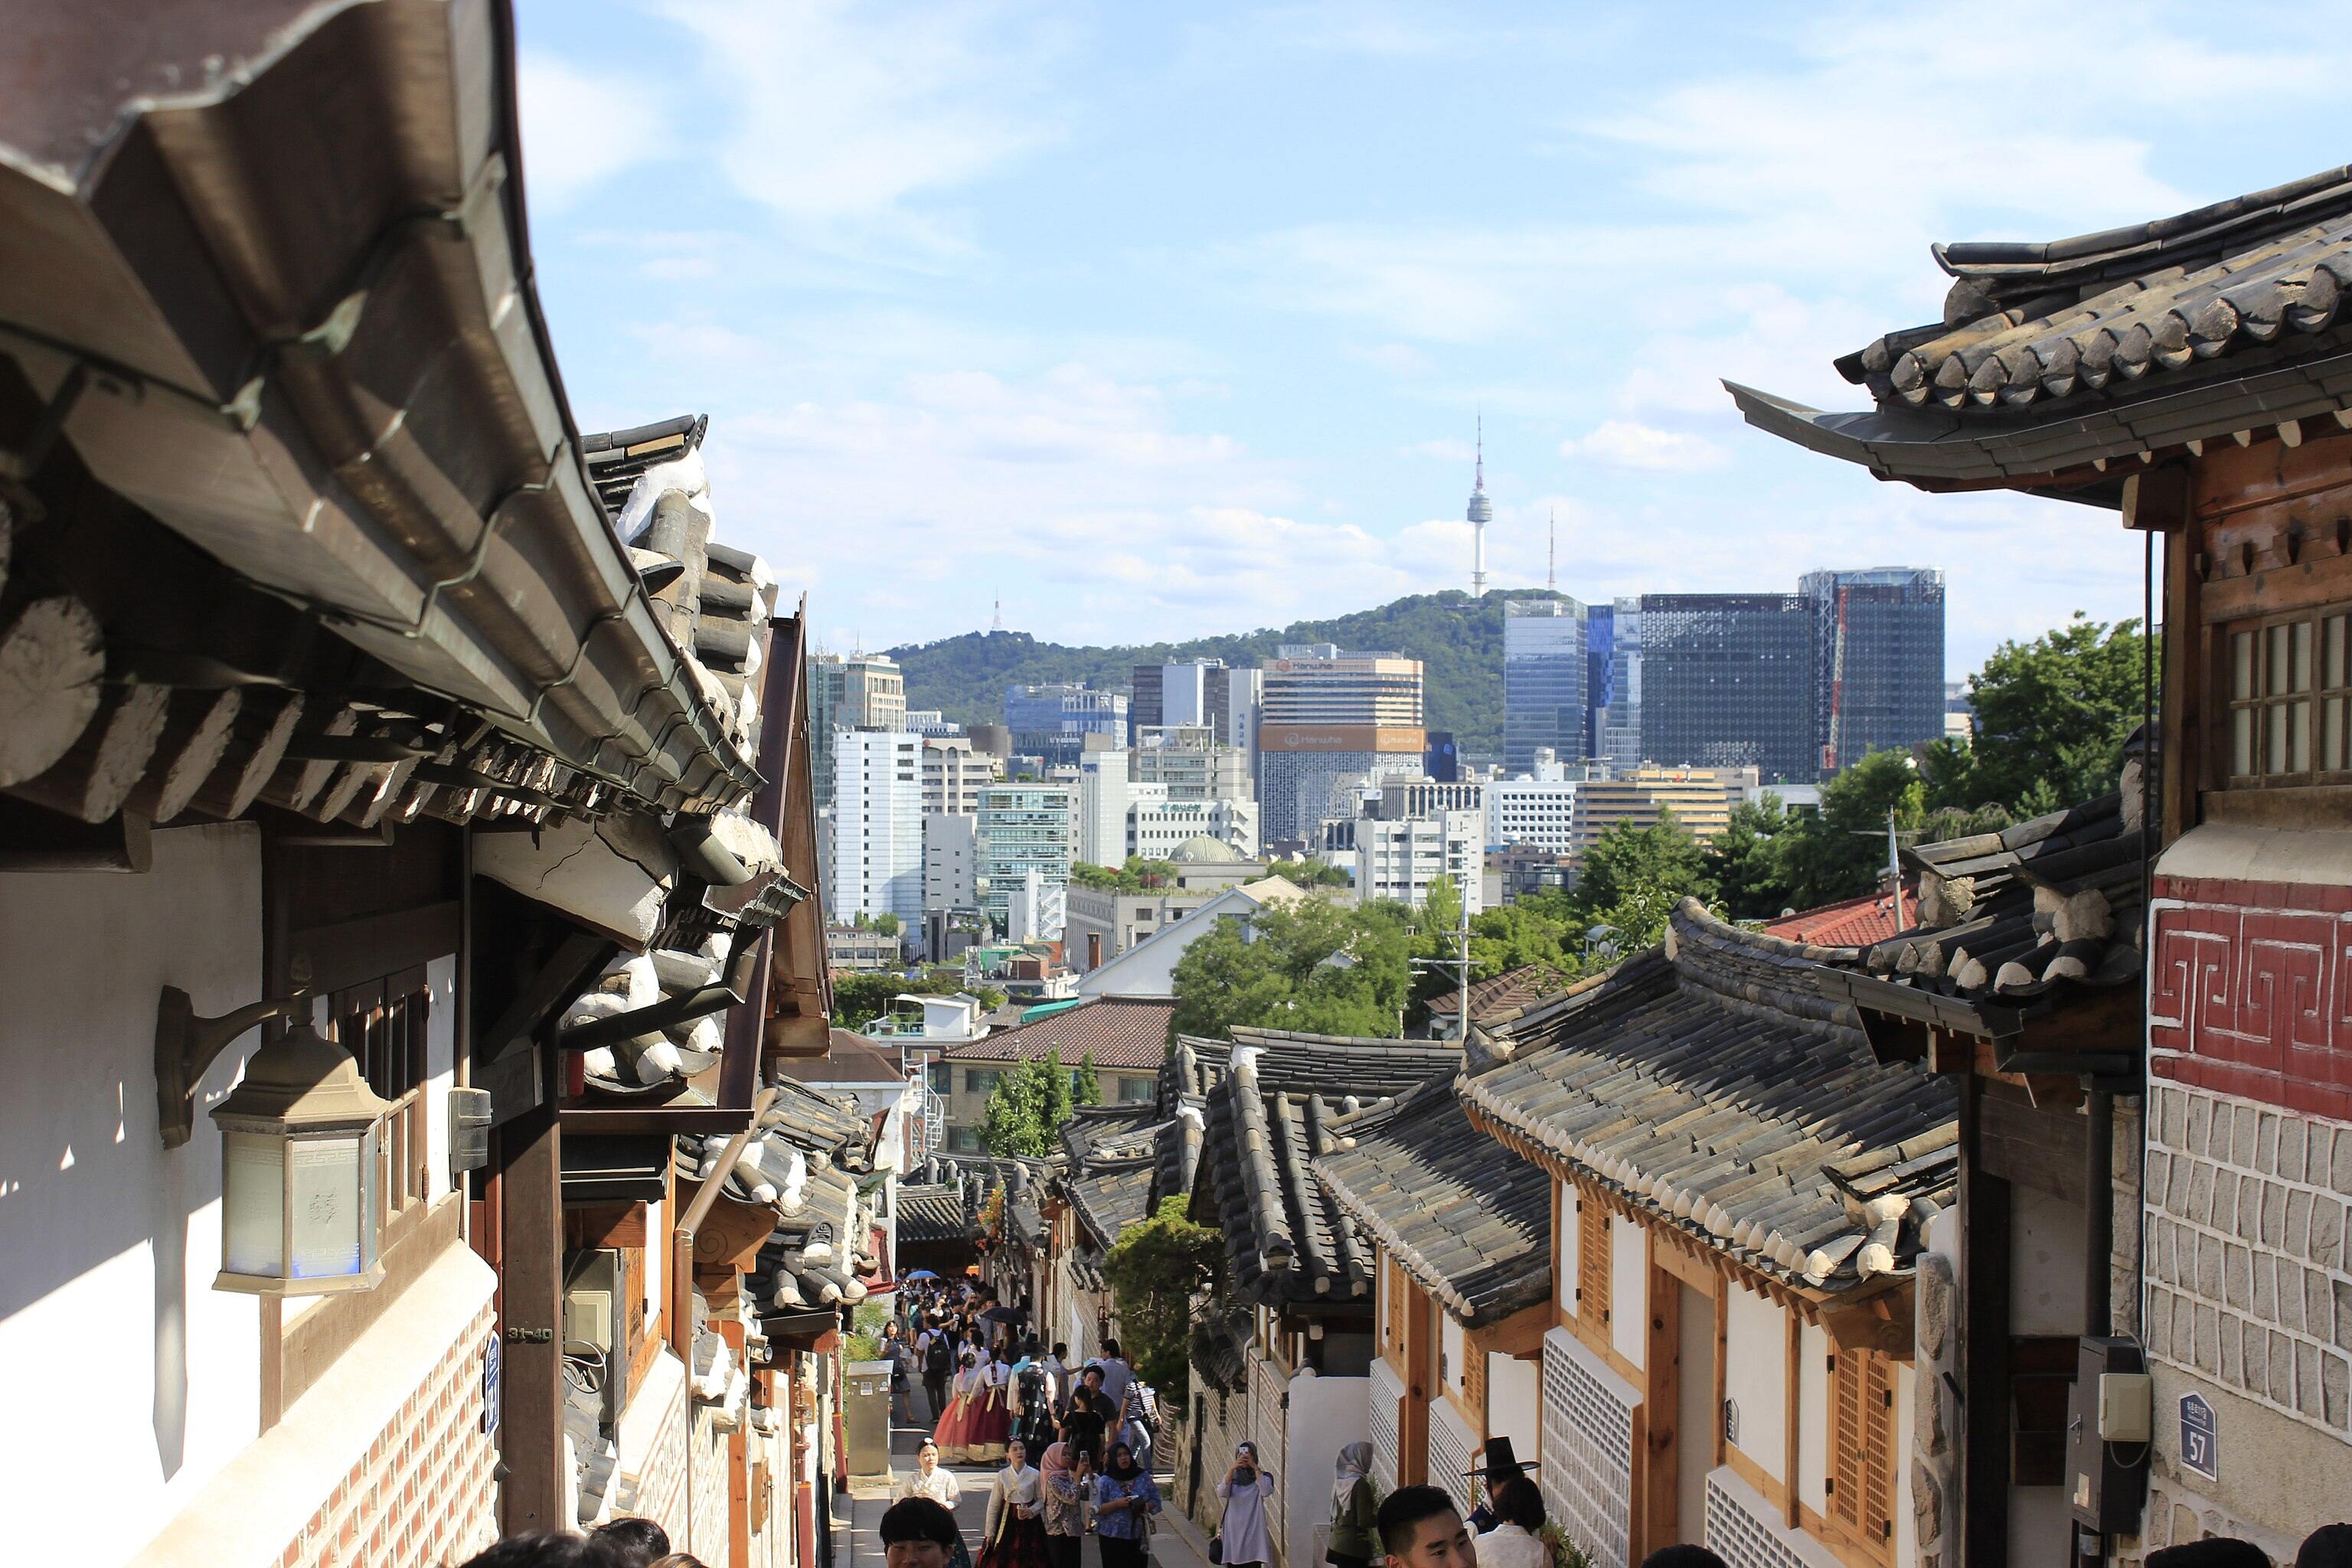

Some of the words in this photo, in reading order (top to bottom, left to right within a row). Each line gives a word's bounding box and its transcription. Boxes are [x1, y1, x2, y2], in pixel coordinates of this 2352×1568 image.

[1292, 662, 1333, 670] Hanwha
[1302, 736, 1342, 744] Hanwha
[508, 1327, 553, 1341] 31-40
[2190, 1431, 2206, 1464] 57
